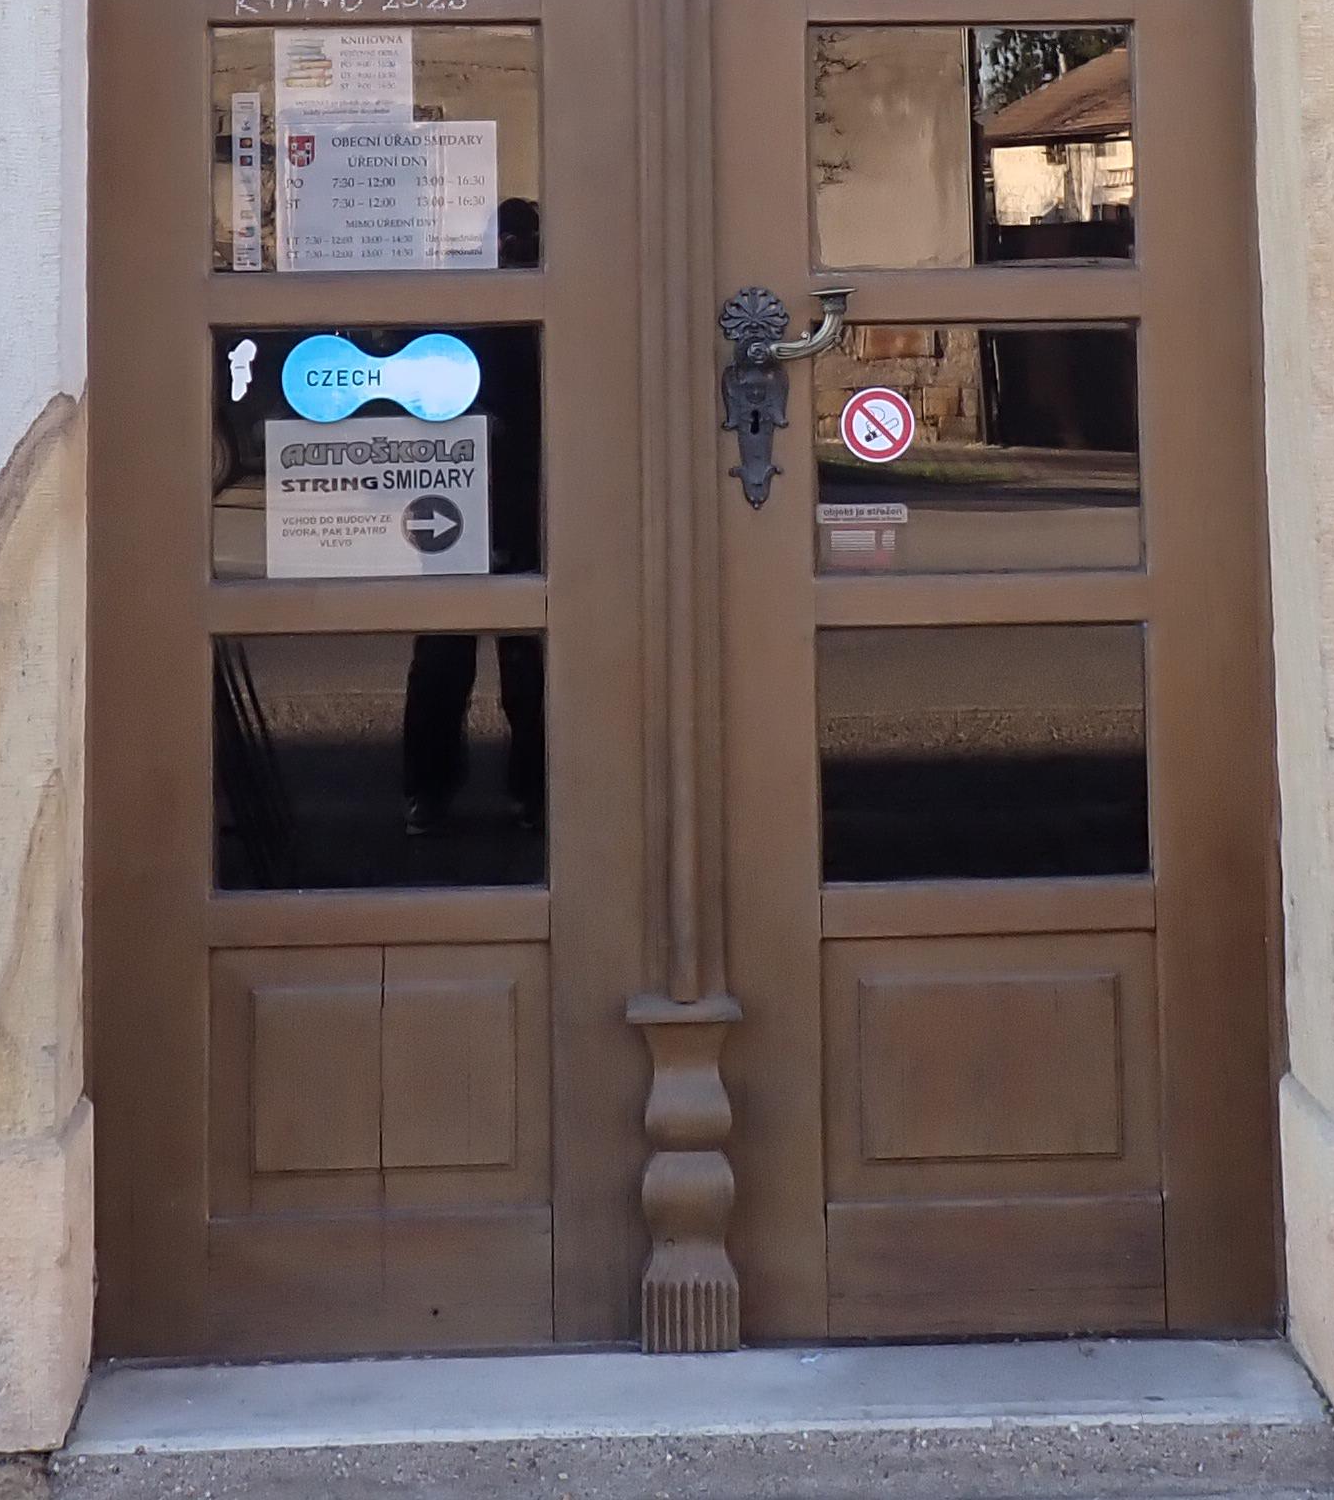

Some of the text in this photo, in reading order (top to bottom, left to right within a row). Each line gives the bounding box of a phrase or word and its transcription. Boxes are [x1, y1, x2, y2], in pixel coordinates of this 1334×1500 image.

[340, 36, 404, 45] KNIHOVNA
[331, 132, 484, 147] OBECNÍ ÚŘAD SMIDARY
[348, 155, 428, 168] ÚŘEDNÍ DNY
[286, 178, 304, 189] PO
[332, 177, 355, 189] 7:30
[368, 177, 396, 188] 12:00
[416, 176, 445, 187] 13:00
[457, 175, 485, 186] 16:30
[332, 197, 355, 208] 7:30
[368, 197, 396, 208] 12:00
[457, 195, 486, 206] 16:30
[346, 220, 375, 229] MIMO
[306, 369, 381, 387] CZECH
[280, 437, 475, 469] AUTOŠKOLA
[281, 468, 475, 492] STRING SMIDARY
[282, 516, 317, 525] VCHOD
[319, 516, 334, 525] DO
[336, 515, 377, 524] BUDOVY
[322, 527, 342, 536] PAK
[320, 539, 352, 548] VLEVO
